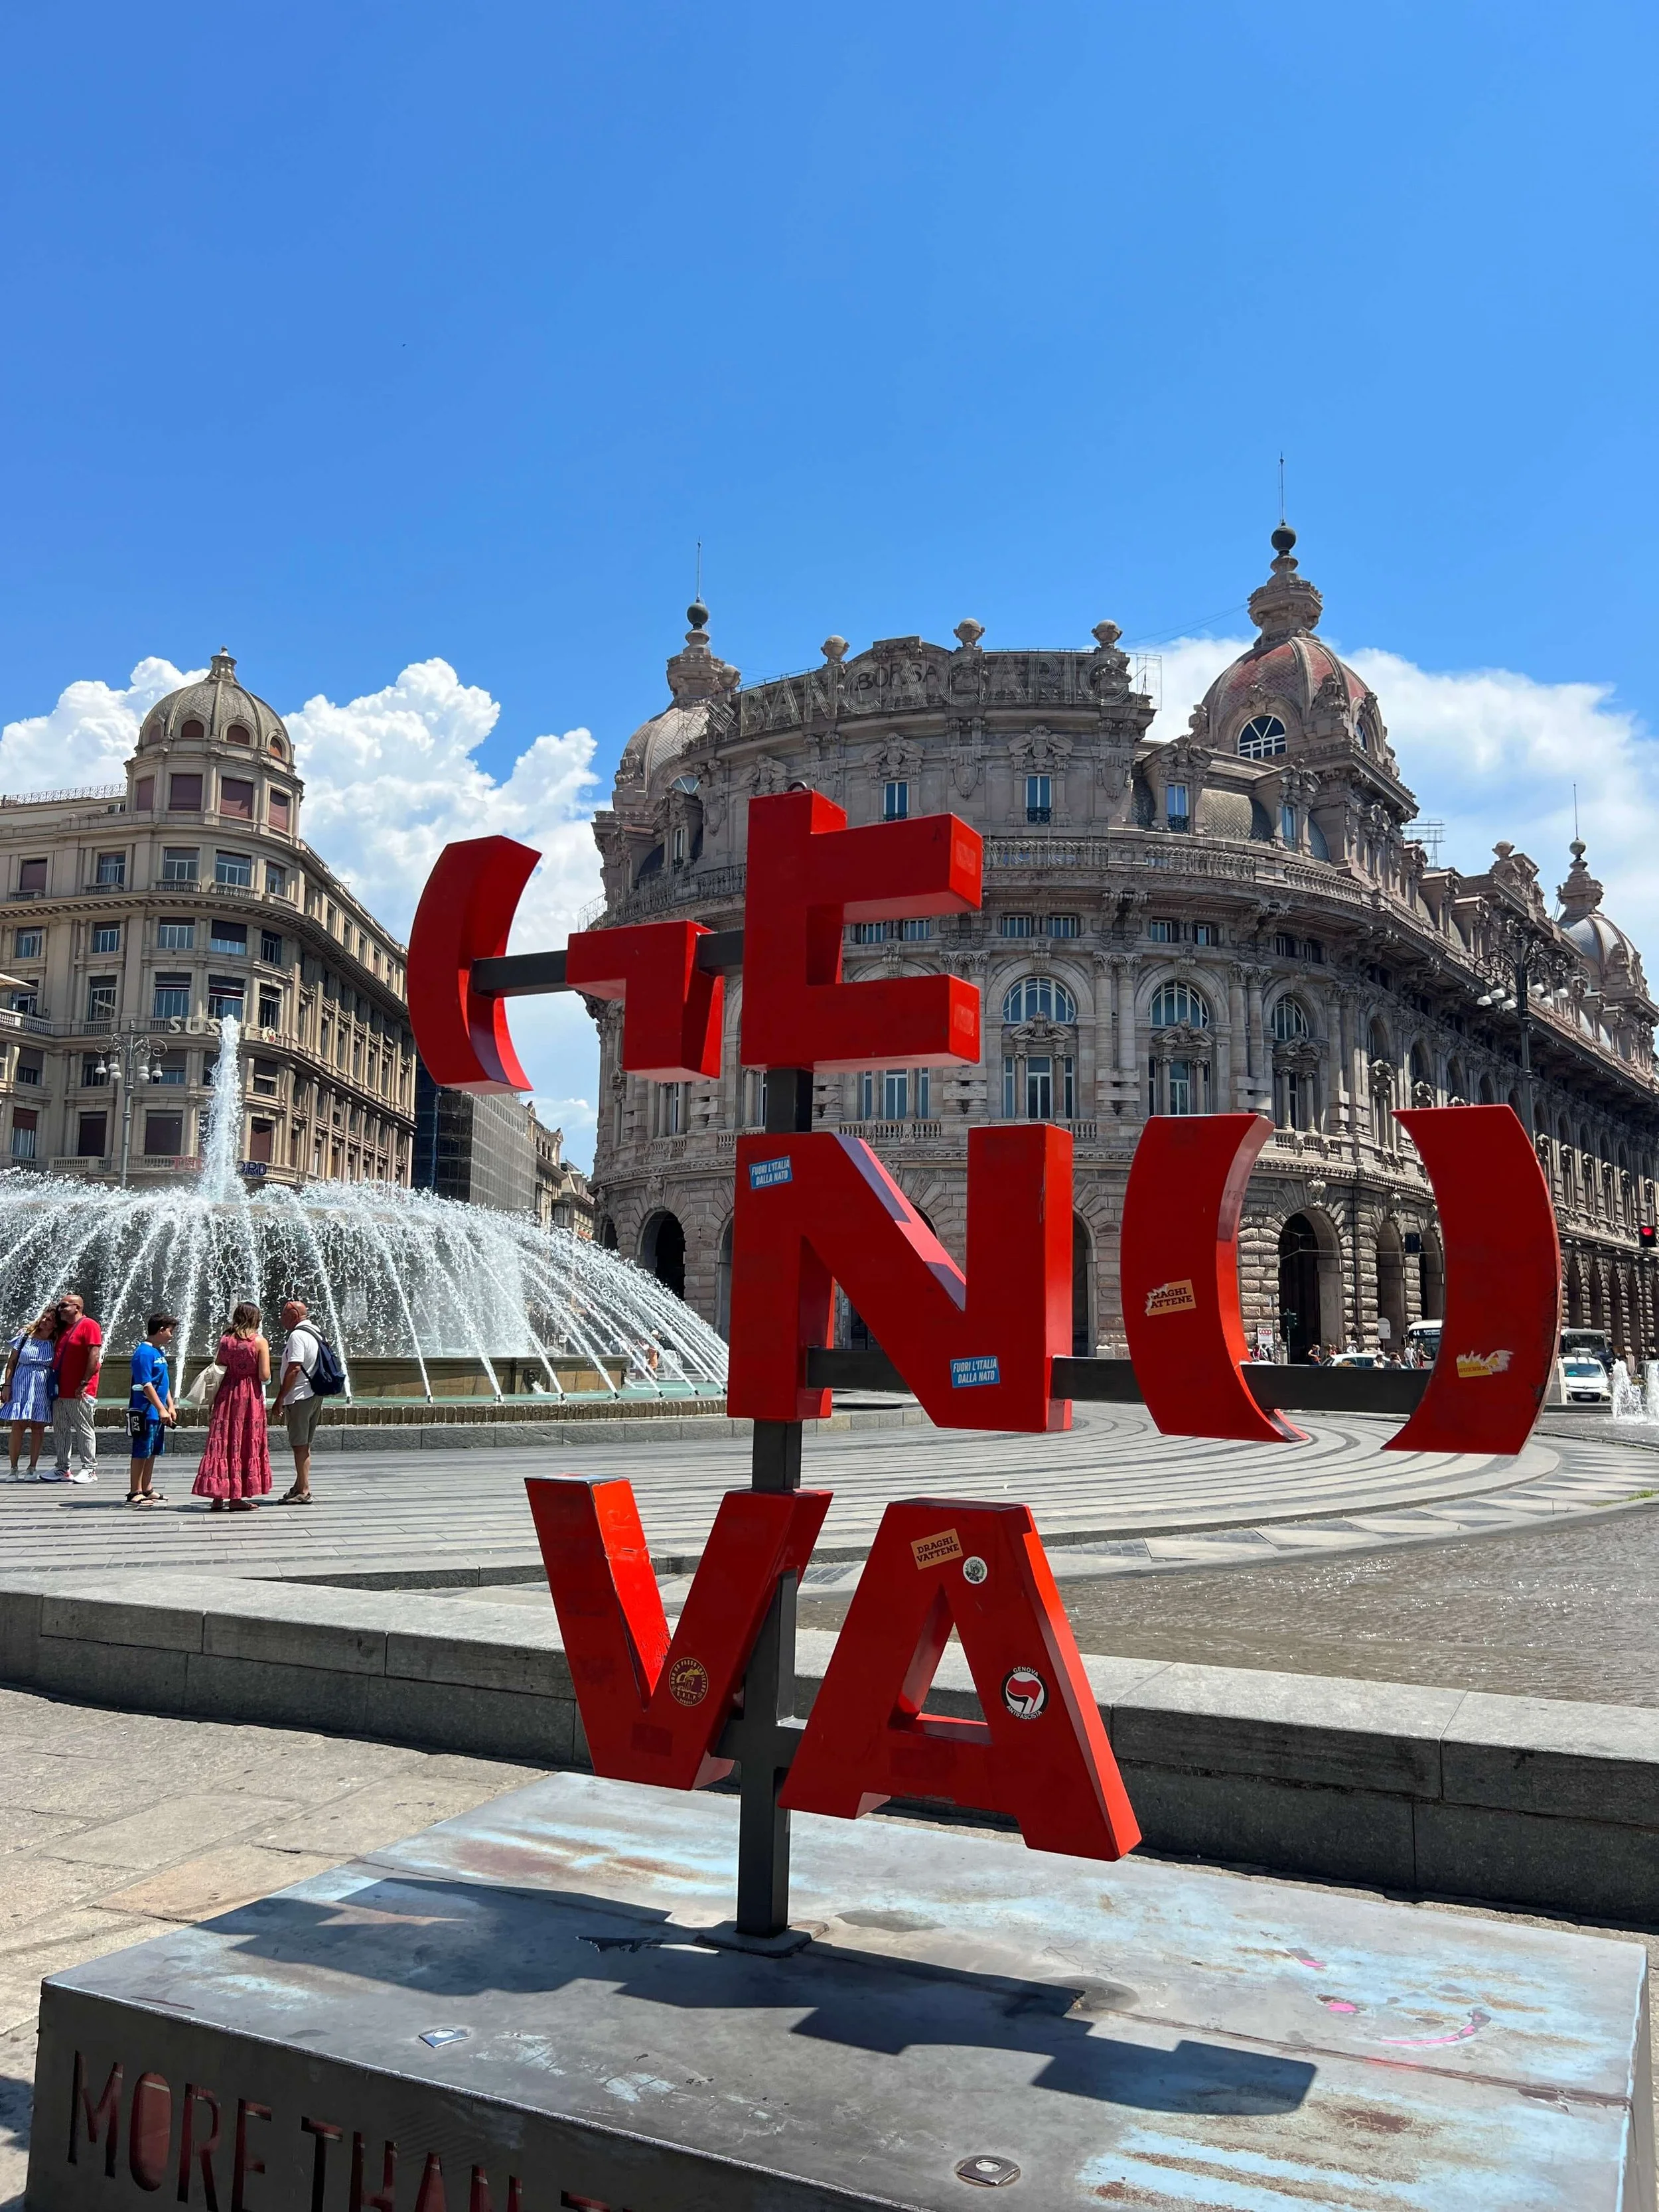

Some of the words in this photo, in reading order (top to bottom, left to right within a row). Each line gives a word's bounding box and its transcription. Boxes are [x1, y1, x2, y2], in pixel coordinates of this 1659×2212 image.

[856, 662, 940, 691] BORSA
[938, 653, 1132, 707] CARIG
[168, 1015, 250, 1041] SUSI
[752, 1163, 767, 1176] FUORI
[768, 1159, 790, 1172] L'ITALIA
[756, 1173, 772, 1185] DALLA
[774, 1169, 788, 1181] NATO
[1151, 1287, 1187, 1299] RAGHI
[1151, 1295, 1192, 1309] ATTENE
[953, 1361, 971, 1373] FUORI
[972, 1358, 997, 1370] L'ITALIA
[958, 1372, 977, 1384] DALLA
[978, 1370, 995, 1381] NATO
[916, 1544, 959, 1562] VATTENE
[917, 1536, 954, 1554] DRAGHI
[1013, 1666, 1039, 1677] GENOVA
[1006, 1705, 1043, 1720] ANTIFASCISTA
[68, 2050, 271, 2212] MORE
